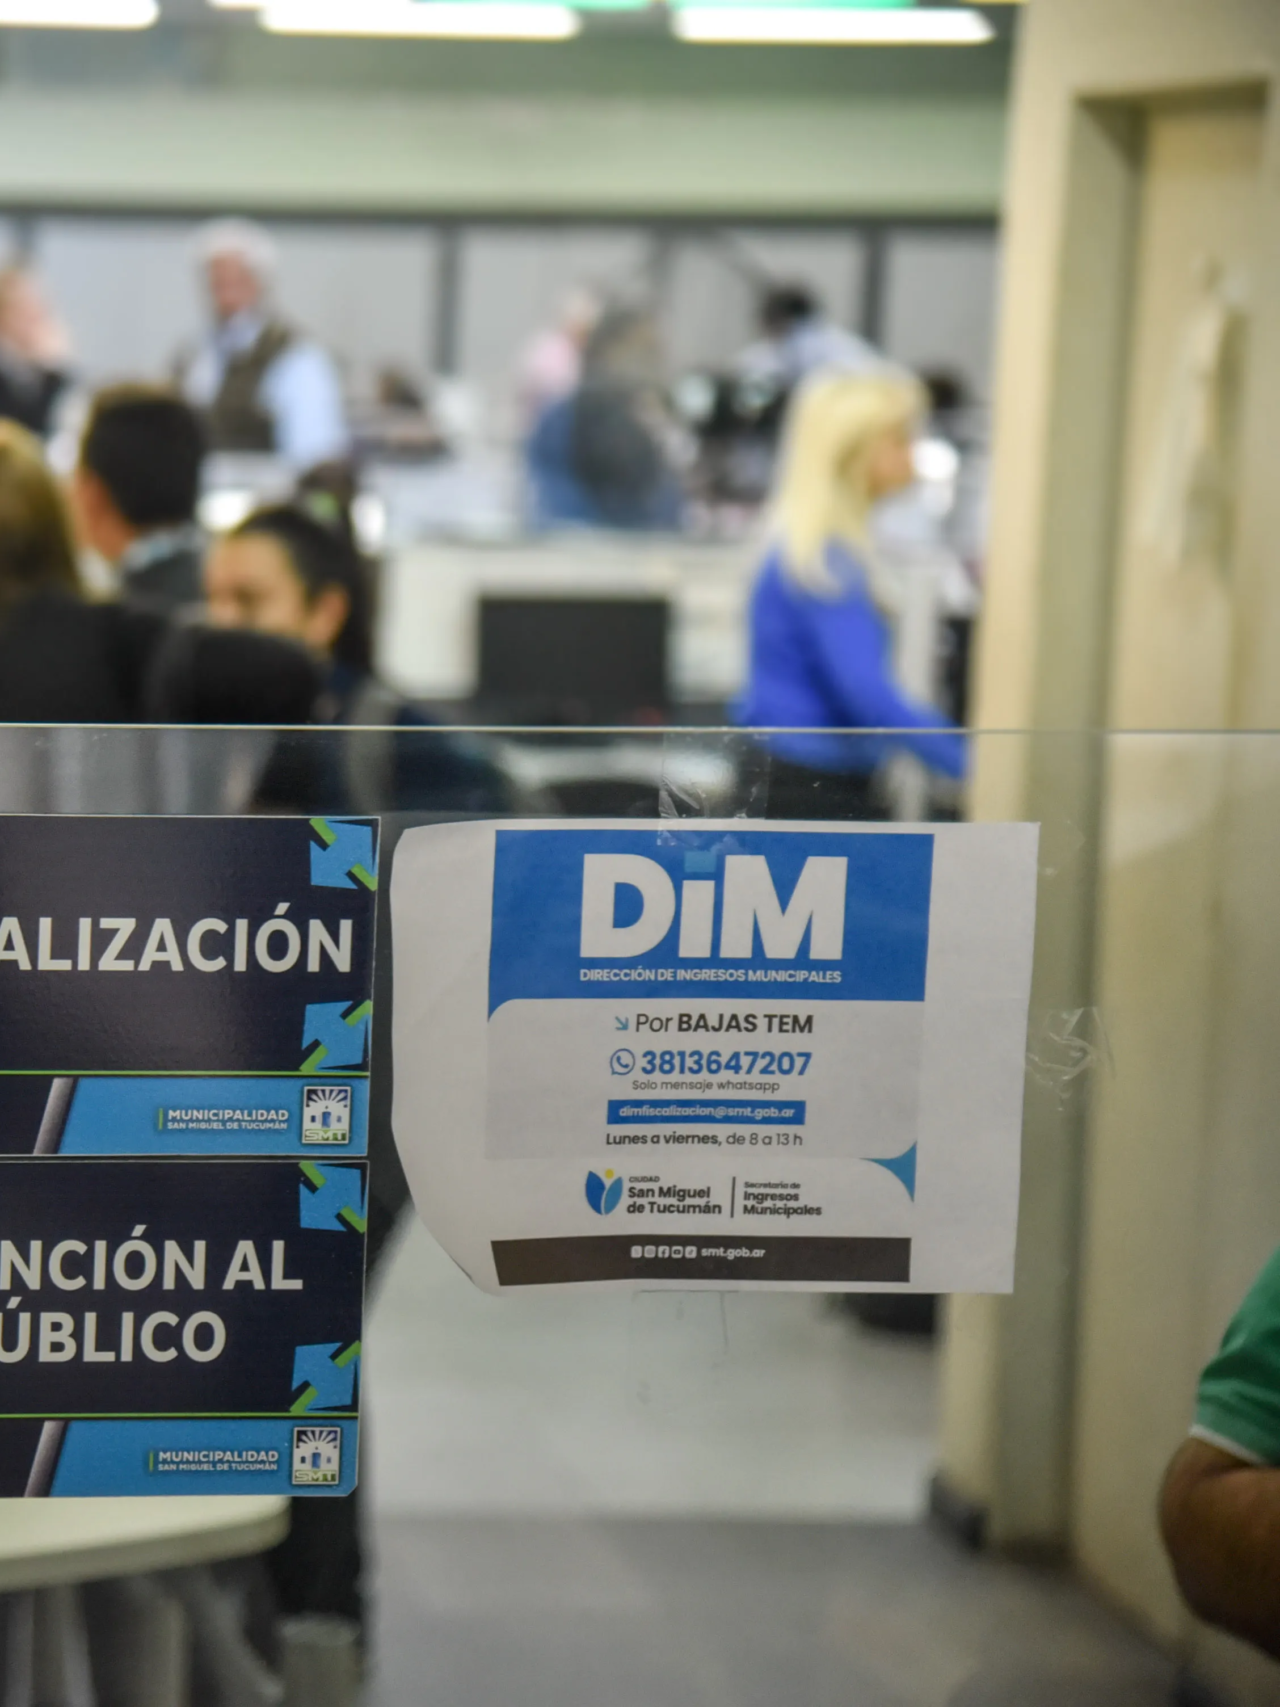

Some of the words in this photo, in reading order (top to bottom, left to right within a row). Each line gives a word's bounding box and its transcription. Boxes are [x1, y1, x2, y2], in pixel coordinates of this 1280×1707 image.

[580, 851, 848, 960] DiM
[580, 966, 656, 981] DIRECCIÓN
[658, 969, 674, 981] DE
[676, 969, 745, 982] INGRESOS
[748, 969, 842, 983] MUNICIPALES
[635, 1013, 673, 1032] Por
[677, 1013, 758, 1033] BAJAS
[763, 1014, 814, 1033] TEM
[641, 1050, 813, 1076] 3813647207
[632, 1079, 658, 1090] Solo
[661, 1080, 714, 1093] mensaje
[717, 1080, 780, 1093] whatsapp
[168, 1109, 289, 1121] MUNICIPALIDAD
[619, 1104, 795, 1120] dimfiscalizacion@smt.gob.ar
[167, 1121, 186, 1130] SAN
[190, 1121, 222, 1130] MIGUEL
[226, 1122, 239, 1130] DE
[240, 1121, 287, 1130] TUCUMÁN
[305, 1130, 347, 1141] SMT
[606, 1133, 648, 1145] Lunes
[651, 1135, 660, 1145] a
[663, 1131, 722, 1147] viernes,
[726, 1133, 746, 1145] de
[749, 1133, 759, 1146] 8
[762, 1135, 772, 1146] a
[776, 1133, 790, 1146] 13
[793, 1133, 803, 1146] h
[744, 1181, 788, 1189] Secretaría
[628, 1186, 656, 1199] San
[658, 1185, 711, 1201] Miguel
[743, 1191, 800, 1204] Ingresos
[627, 1201, 645, 1214] de
[648, 1201, 722, 1214] Tucumán
[743, 1203, 822, 1218] Municipales
[701, 1247, 766, 1260] smt.gob.ar
[222, 1239, 303, 1290] AL
[159, 1451, 279, 1462] MUNICIPALIDAD
[158, 1463, 176, 1471] SAN
[179, 1463, 214, 1471] MIGUEL
[217, 1463, 229, 1471] DE
[231, 1462, 277, 1471] TUCUMÁN
[295, 1471, 336, 1482] SMT
